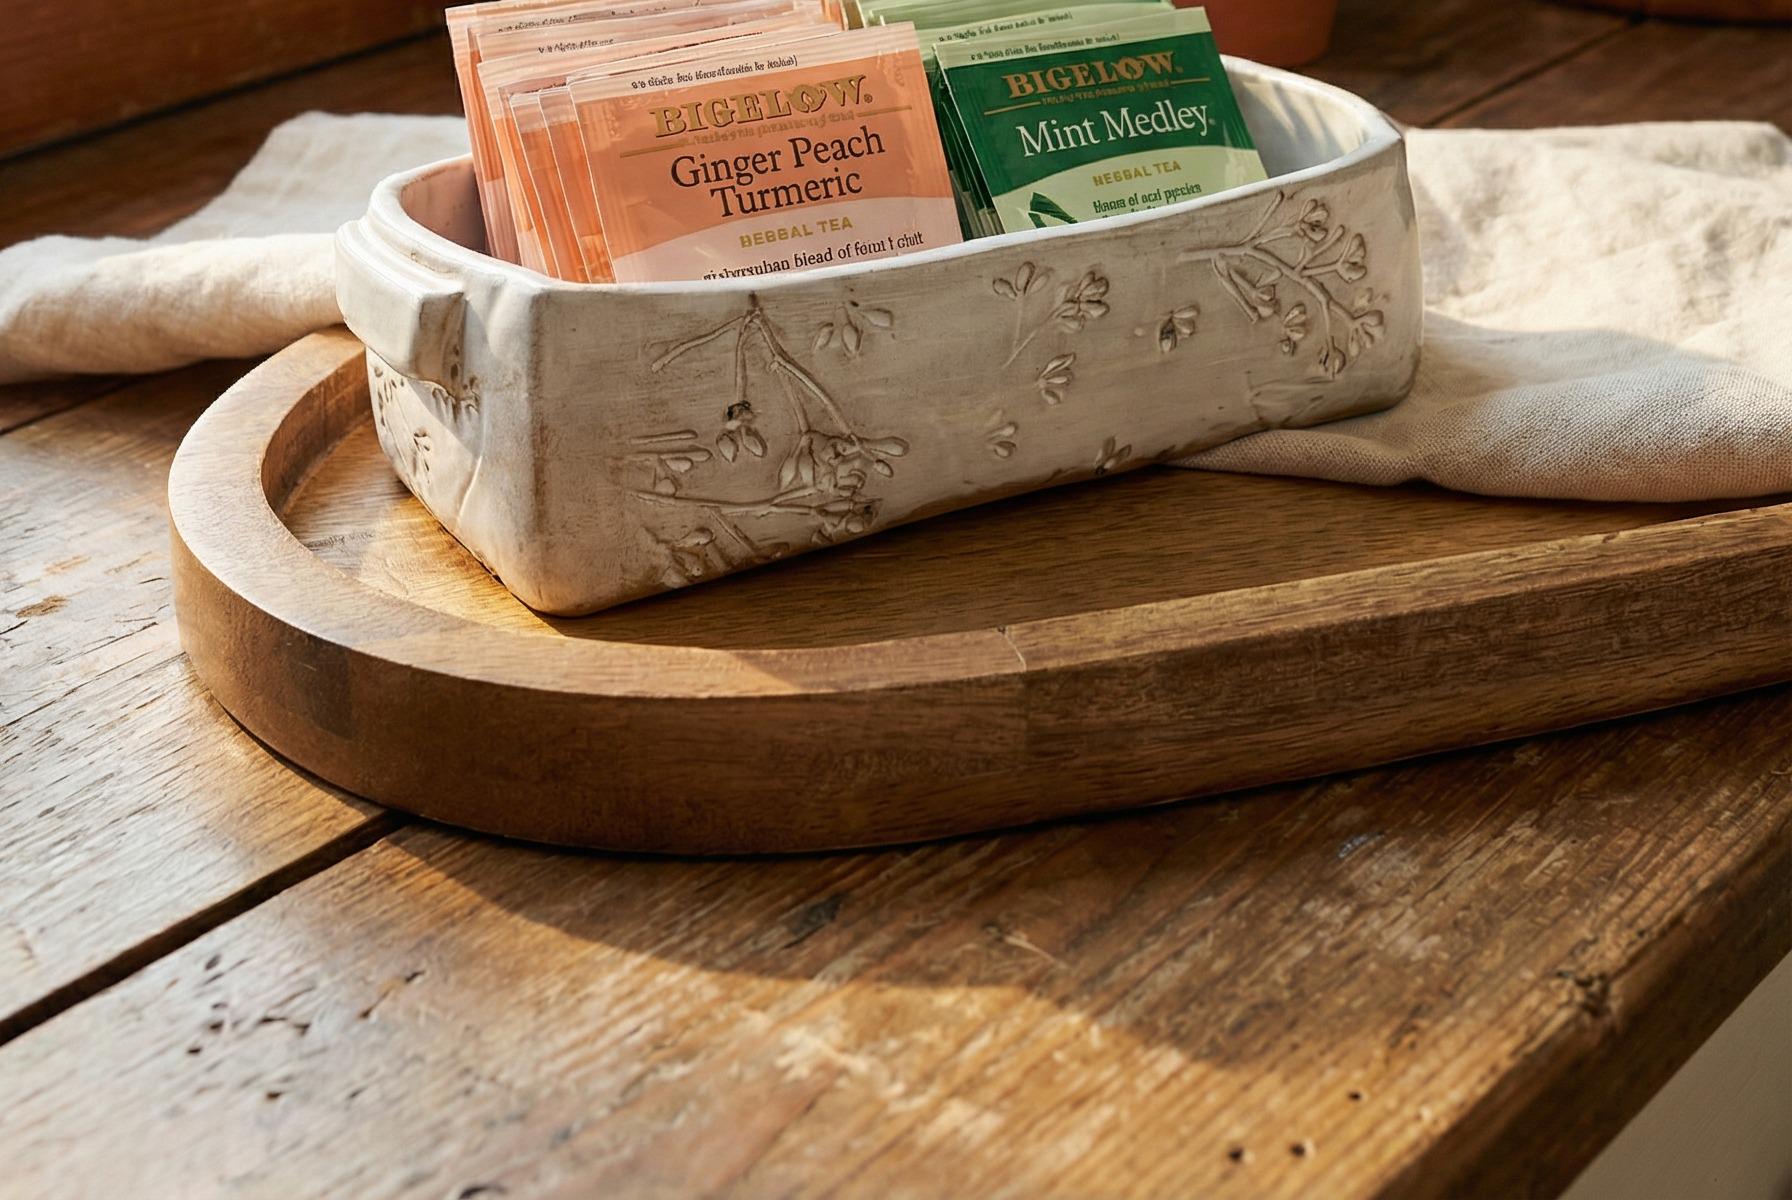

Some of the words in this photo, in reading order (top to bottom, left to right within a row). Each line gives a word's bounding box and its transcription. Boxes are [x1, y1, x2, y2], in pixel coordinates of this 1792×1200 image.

[671, 149, 782, 188] Ginger
[788, 125, 886, 168] Peach
[1016, 118, 1100, 158] Mint
[1153, 160, 1182, 174] TEA
[710, 167, 863, 217] Turmeric
[816, 216, 854, 233] TEA
